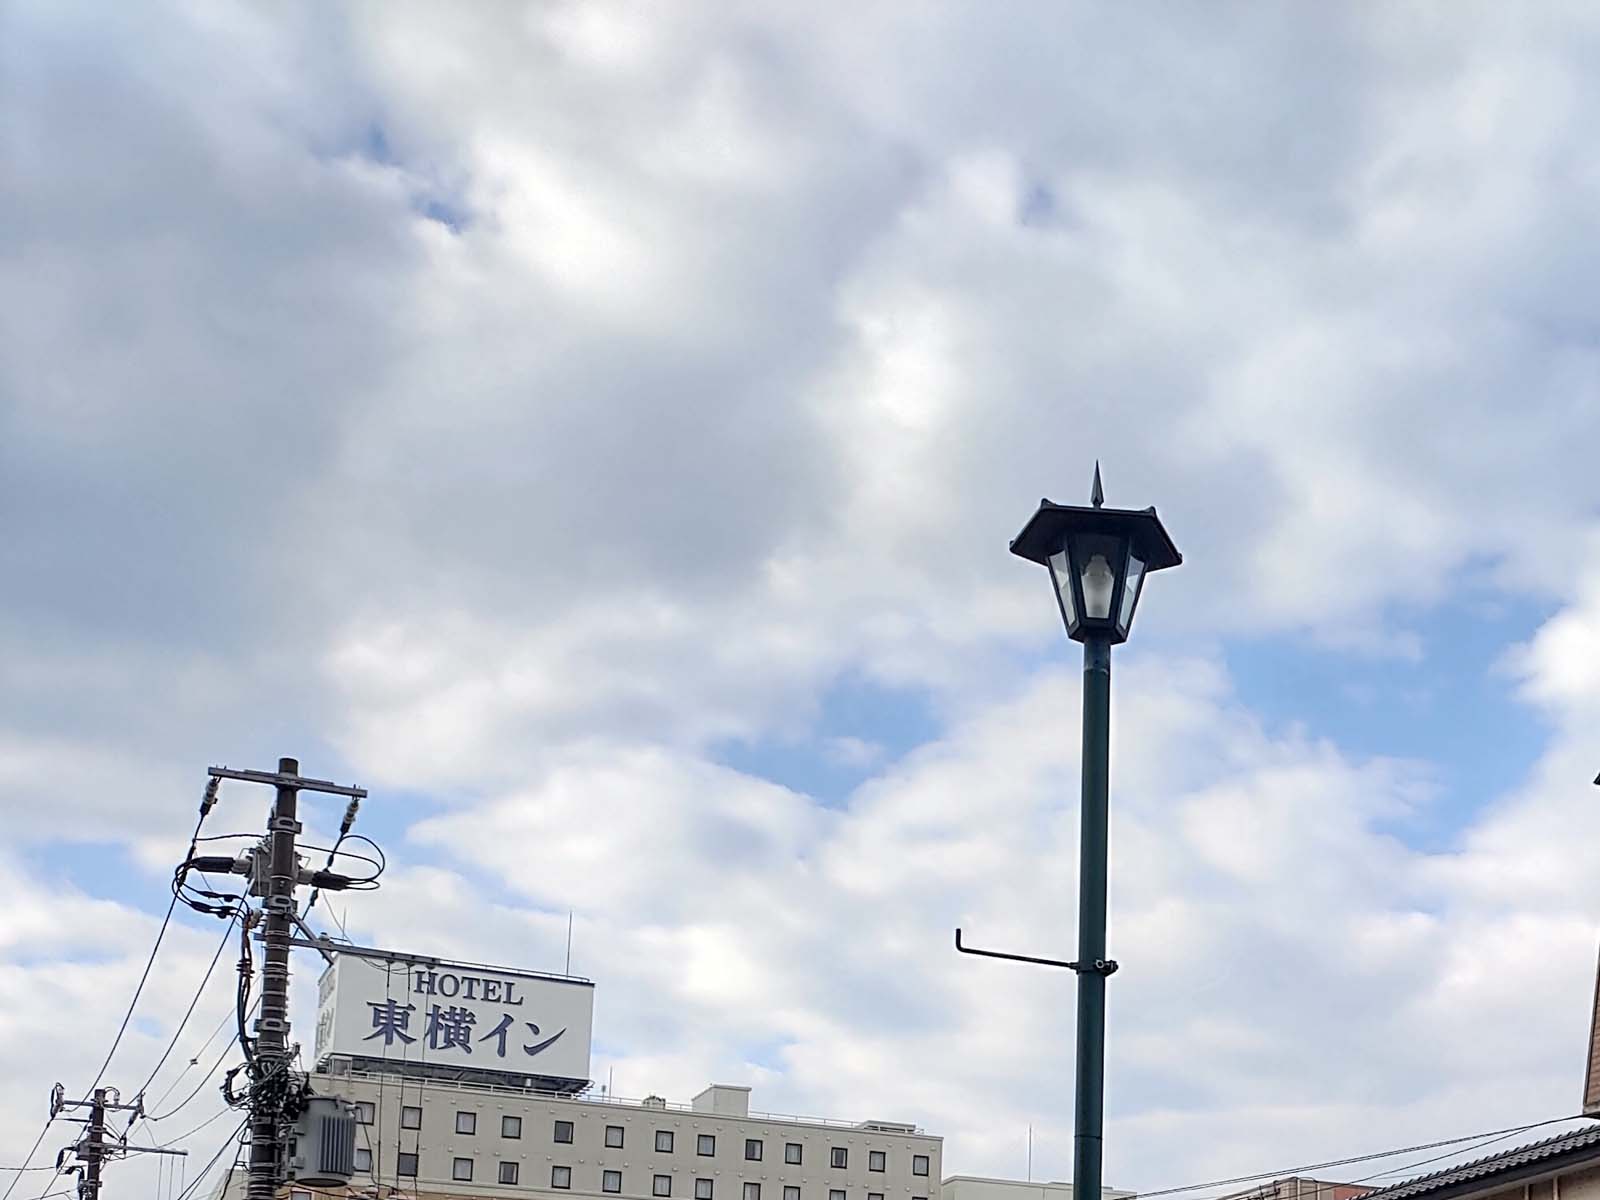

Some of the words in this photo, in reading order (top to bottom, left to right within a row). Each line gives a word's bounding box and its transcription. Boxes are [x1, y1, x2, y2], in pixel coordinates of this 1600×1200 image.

[413, 969, 525, 1006] HOTEL
[362, 998, 568, 1058] 東横イン
